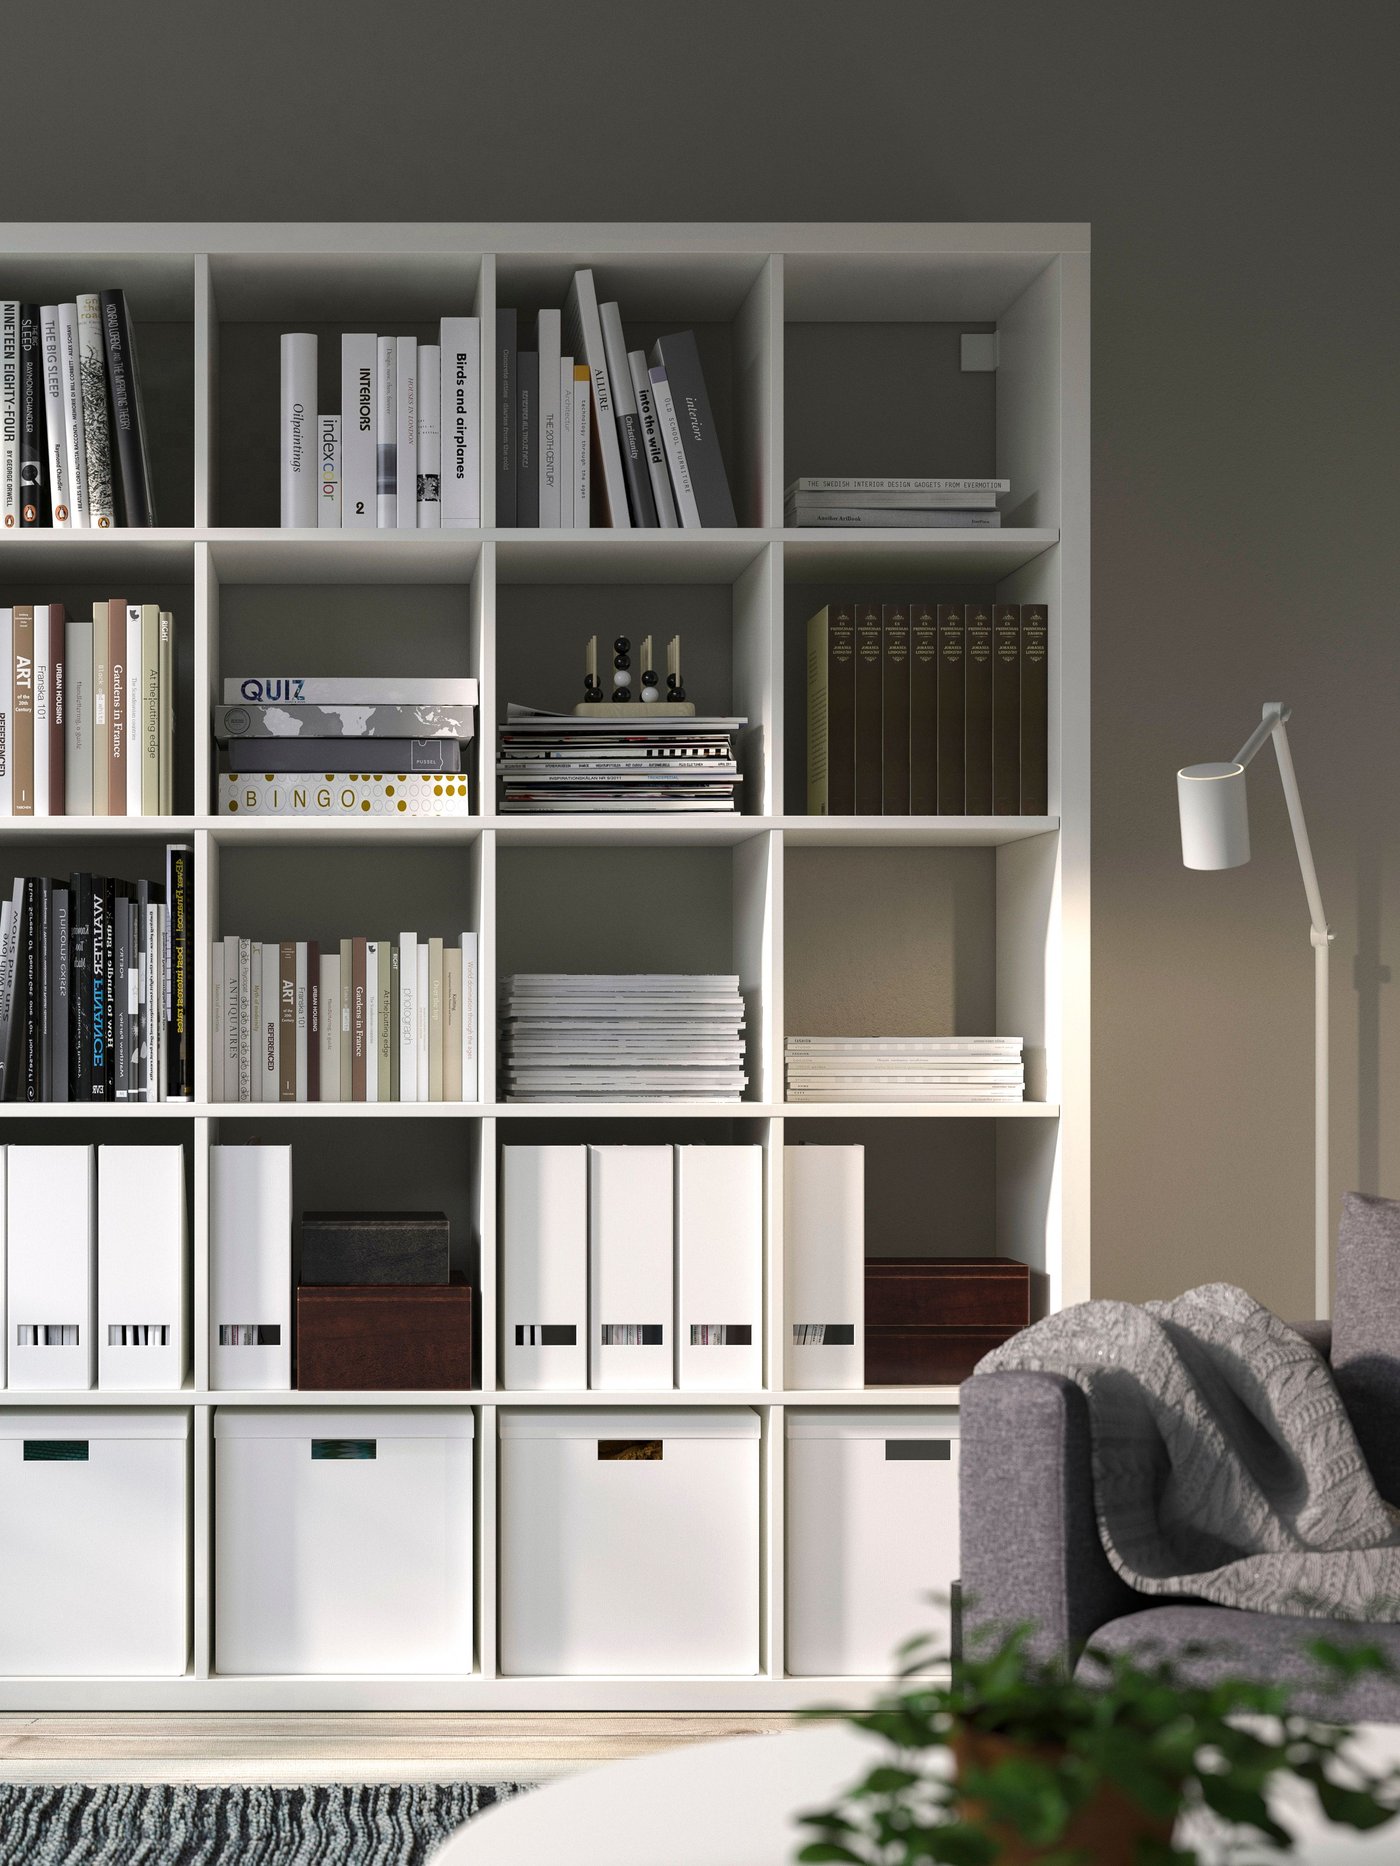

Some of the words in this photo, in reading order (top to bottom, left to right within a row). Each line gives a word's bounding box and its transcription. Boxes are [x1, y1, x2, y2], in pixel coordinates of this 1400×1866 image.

[4, 304, 15, 359] NINETEEN
[45, 320, 54, 343] THE
[106, 304, 120, 328] KONRAD
[22, 320, 31, 351] SLEEP
[109, 328, 122, 351] LORENZ
[46, 345, 56, 364] BIG
[114, 362, 124, 374] THE
[456, 353, 466, 385] Birds
[25, 362, 33, 395] RAYMOND
[48, 366, 59, 398] SLEEP
[115, 375, 128, 407] IMPRINTING
[595, 369, 609, 411] ALLURE
[4, 364, 15, 441] EIGHTY-FOUR
[25, 397, 33, 432] CHANDLER
[360, 368, 370, 431] INTERIORS
[408, 406, 414, 414] IN
[456, 389, 467, 414] and
[639, 390, 649, 413] into
[119, 407, 130, 430] THEORY
[546, 414, 554, 428] THE
[643, 416, 654, 435] the
[686, 397, 702, 441] interiors
[290, 403, 304, 472] Oilpaintings
[454, 418, 466, 479] airplanes
[546, 430, 554, 450] 20TH
[625, 416, 639, 459] Christianity
[647, 437, 662, 463] wild
[546, 452, 554, 487] CENTURY
[668, 418, 680, 445] SCHOOL
[677, 451, 690, 494] FURNITURE
[356, 502, 365, 514] 2
[17, 656, 31, 688] ART
[38, 666, 46, 700] Franska
[114, 665, 122, 707] Gardens
[150, 670, 157, 680] At
[241, 679, 305, 702] QUIZ
[38, 704, 46, 719] 101
[114, 710, 122, 719] in
[148, 701, 157, 732] cutting
[114, 723, 122, 757] France
[148, 735, 157, 758] edge
[246, 790, 355, 808] BINGO
[3, 993, 11, 1022] Sun
[10, 911, 18, 953] Snow
[283, 980, 293, 1004] ART
[384, 990, 389, 998] At
[228, 978, 237, 1059] ANTIQUAIRES
[402, 988, 413, 1045] photograph
